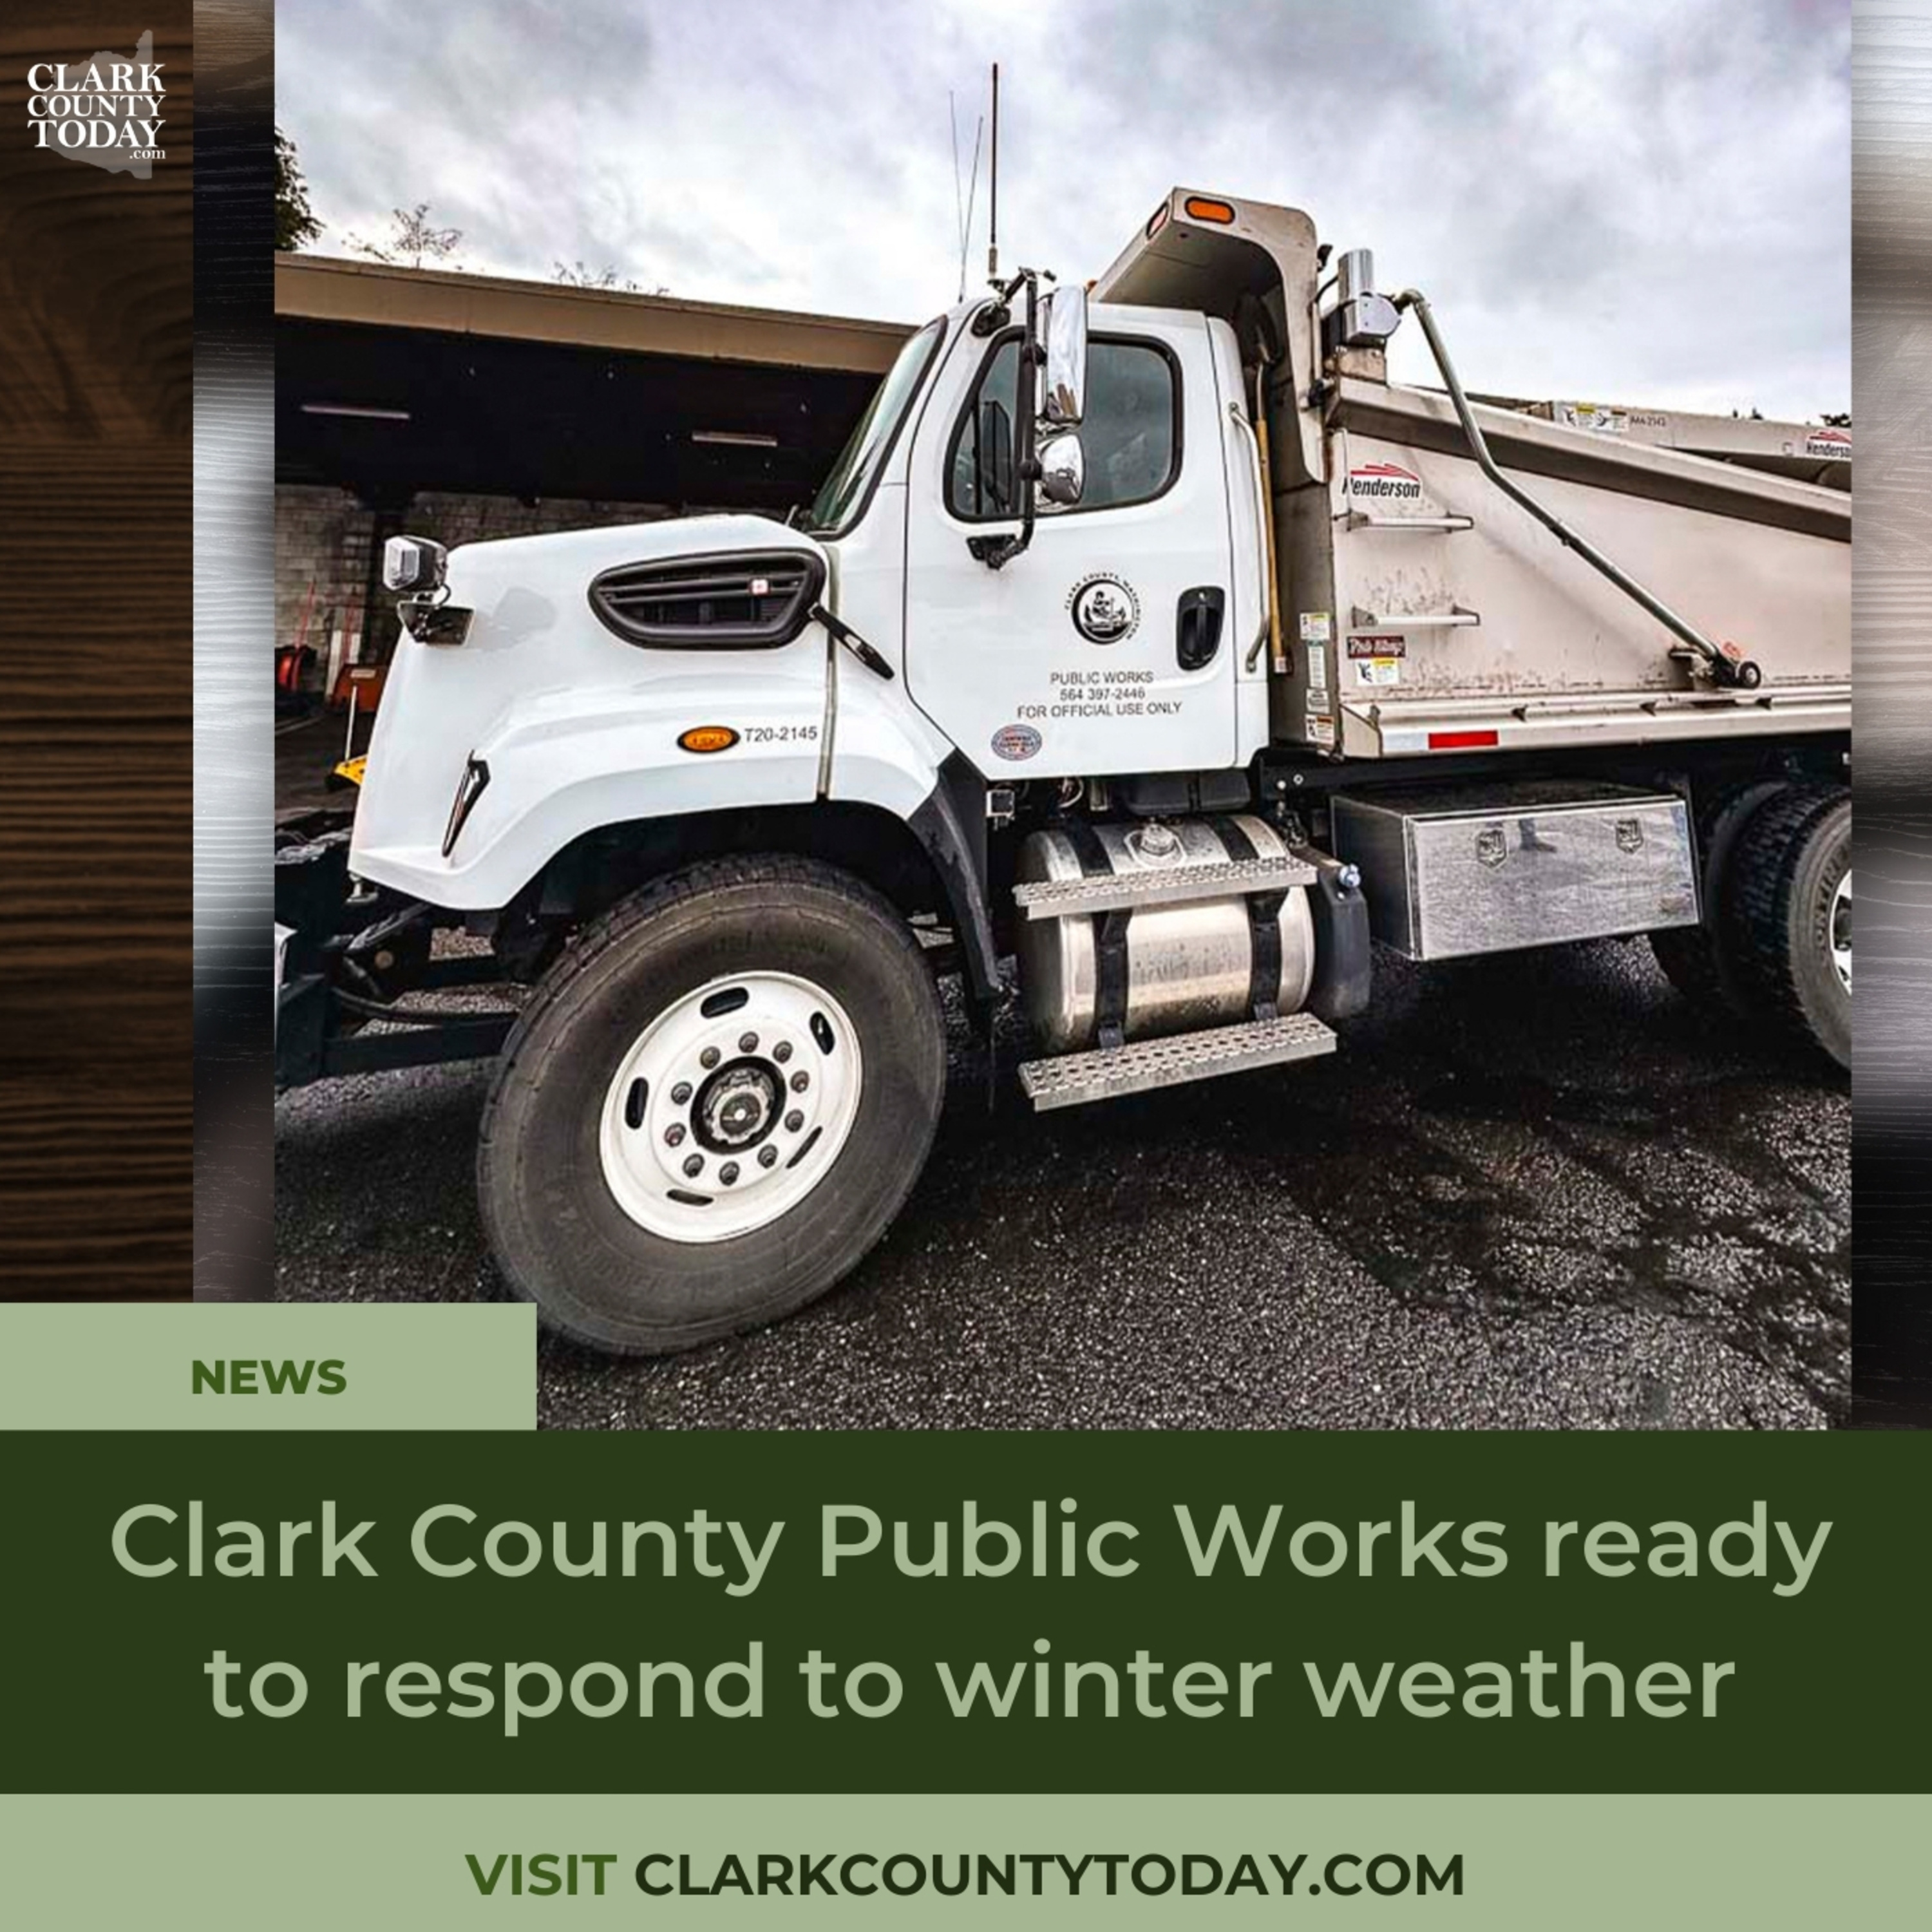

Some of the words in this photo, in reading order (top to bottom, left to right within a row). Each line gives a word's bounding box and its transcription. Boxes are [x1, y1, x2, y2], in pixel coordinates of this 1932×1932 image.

[1050, 672, 1100, 685] PUBLIC
[1103, 670, 1154, 685] WORKS
[1059, 687, 1084, 701] 564
[1087, 686, 1146, 701] 397-2446
[1017, 705, 1047, 719] FOR
[1050, 704, 1113, 718] OFFICIAL
[1116, 703, 1144, 716] USE
[1146, 701, 1182, 715] ONLY
[744, 726, 818, 742] T20-2145
